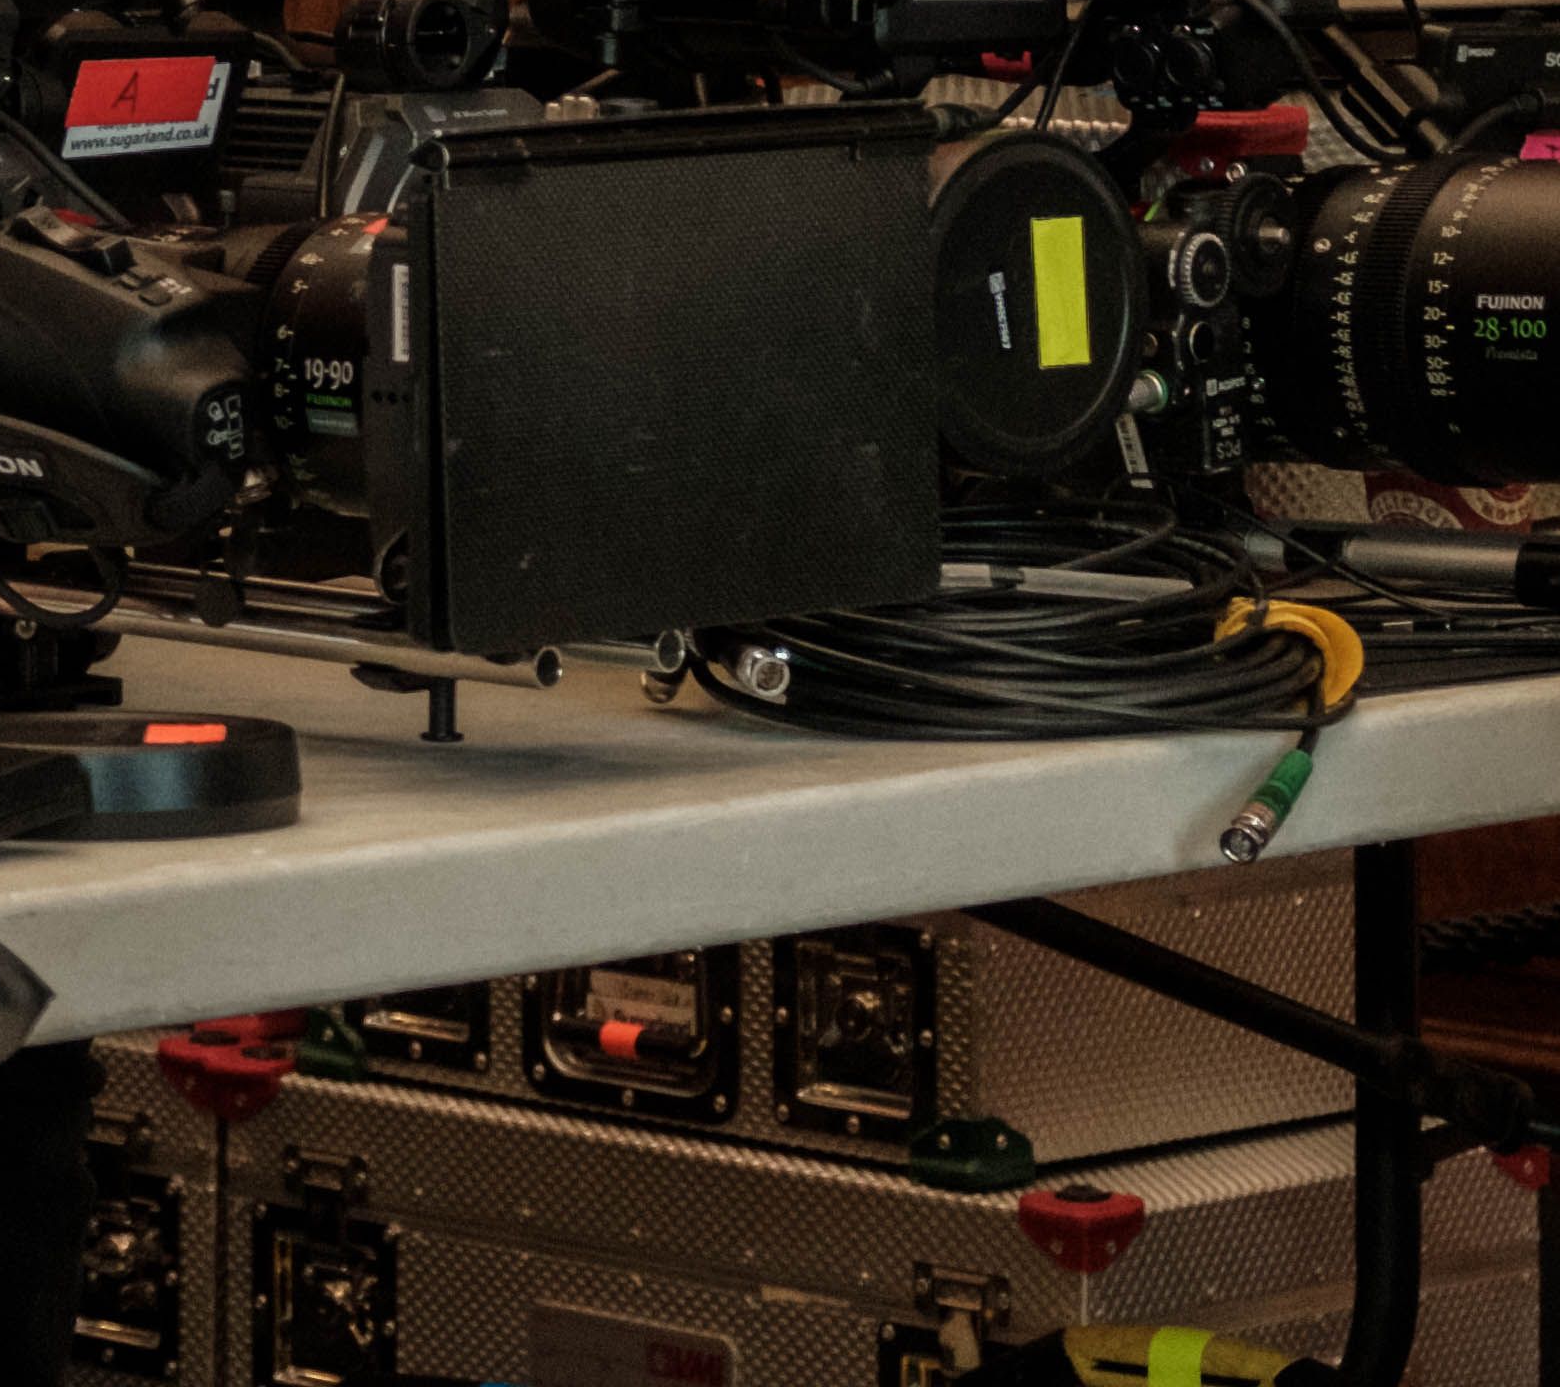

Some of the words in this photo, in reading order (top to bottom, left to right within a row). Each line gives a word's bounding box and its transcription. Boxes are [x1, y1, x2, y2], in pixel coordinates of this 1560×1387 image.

[112, 70, 140, 115] A
[70, 125, 210, 151] www.sugarland.co.uk
[1433, 252, 1447, 265] 12
[1428, 280, 1442, 294] 15
[1476, 294, 1545, 311] FUJINON
[1423, 307, 1440, 321] 20
[1473, 316, 1548, 342] 28-100
[1423, 335, 1440, 349] 30
[303, 358, 355, 390] 19-90
